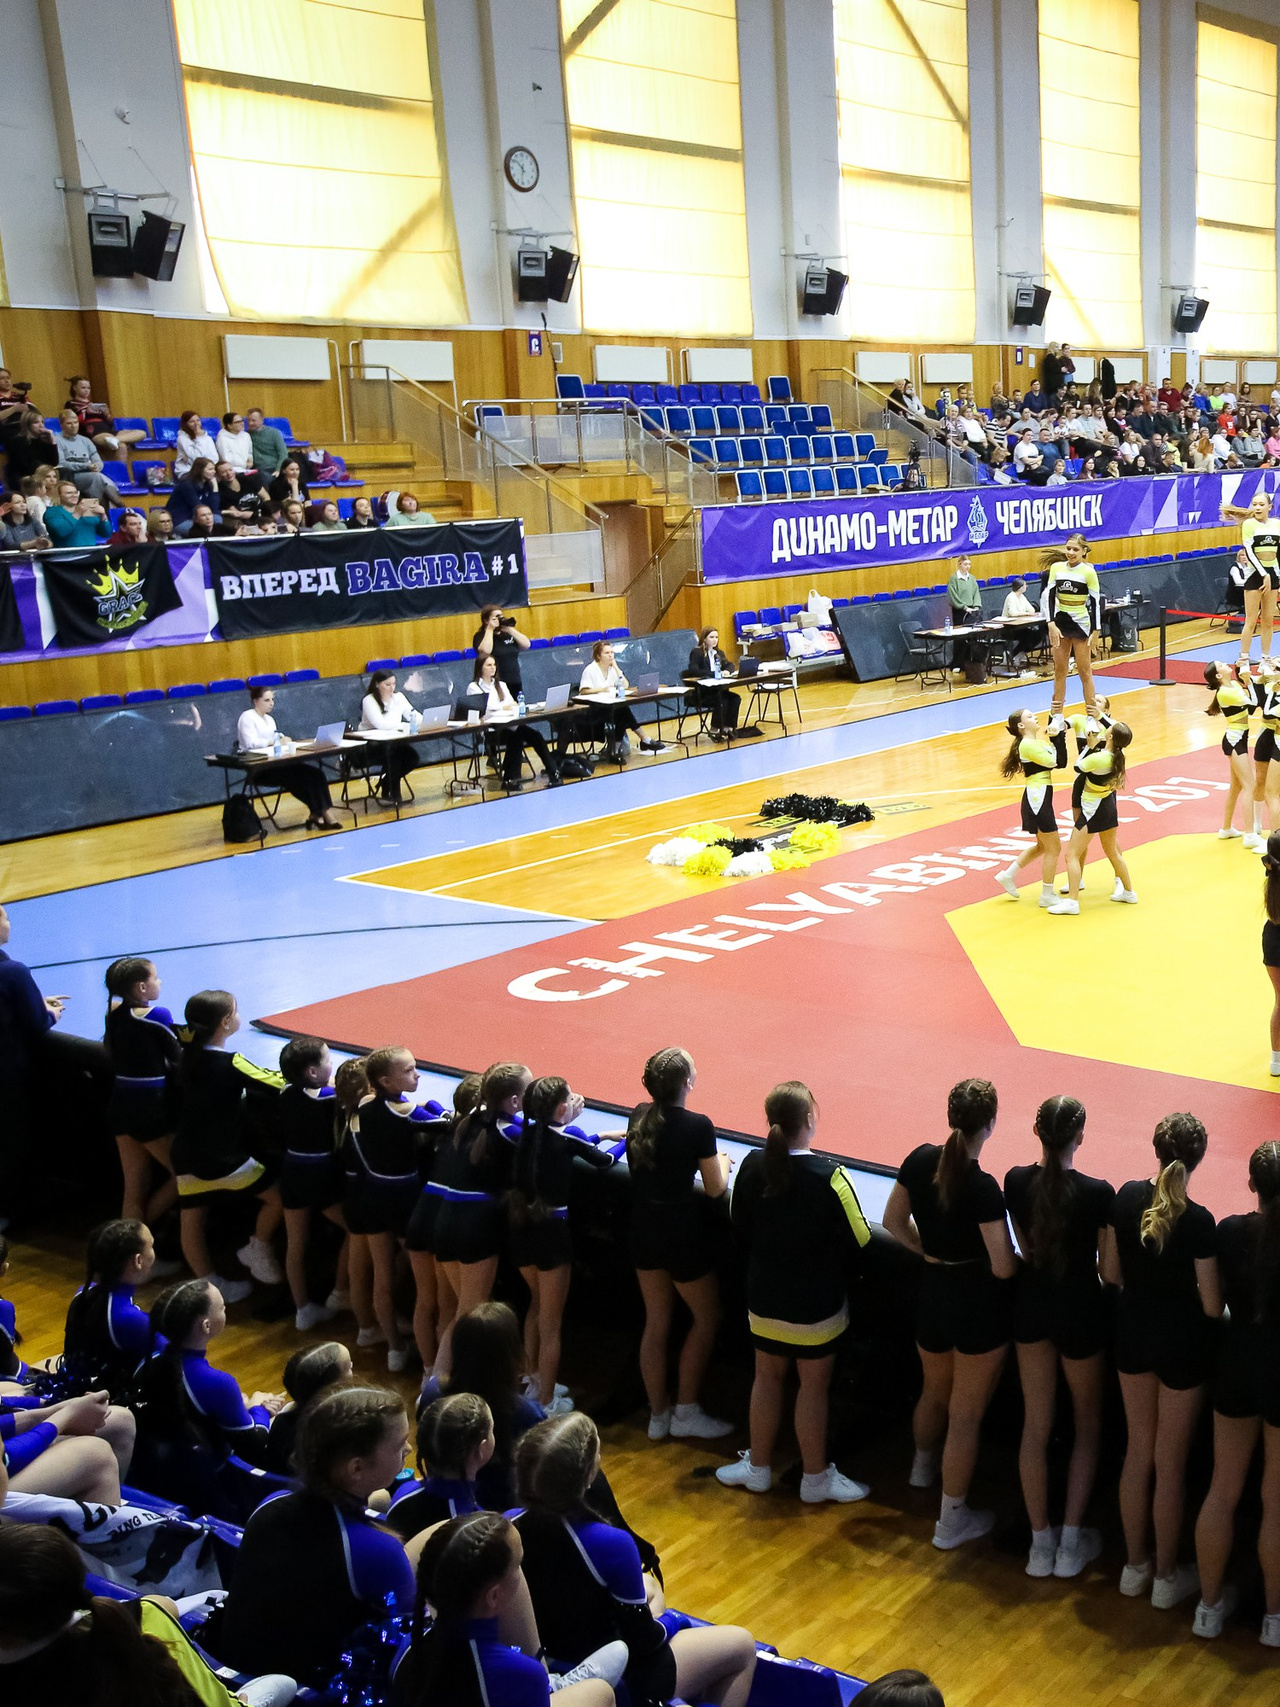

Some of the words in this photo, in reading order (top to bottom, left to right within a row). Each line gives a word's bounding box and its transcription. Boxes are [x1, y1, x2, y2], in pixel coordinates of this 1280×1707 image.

[771, 505, 958, 564] ДИНАМО-МЕТАР
[995, 494, 1103, 536] ЧЕЛЯБИНСК
[220, 567, 341, 601] ВПЕРЕД
[345, 552, 489, 596] BAGIRA
[507, 808, 1140, 1002] CHELYABINS
